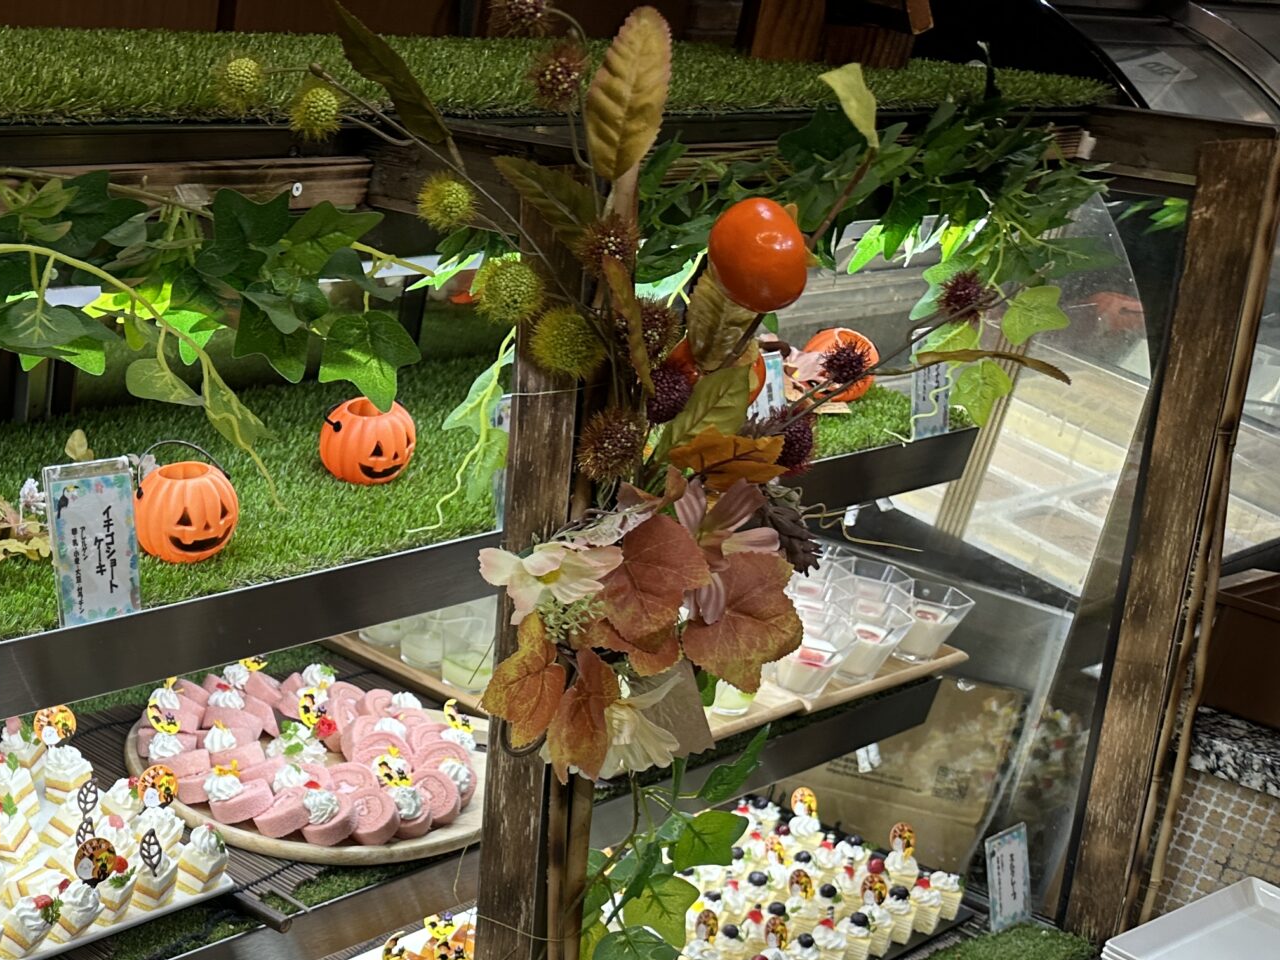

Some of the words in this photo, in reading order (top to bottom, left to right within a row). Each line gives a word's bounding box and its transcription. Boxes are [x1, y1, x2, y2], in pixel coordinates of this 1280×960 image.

[80, 526, 89, 561] アレルゲン
[93, 536, 107, 576] ケーキ
[102, 505, 119, 594] イチゴショート
